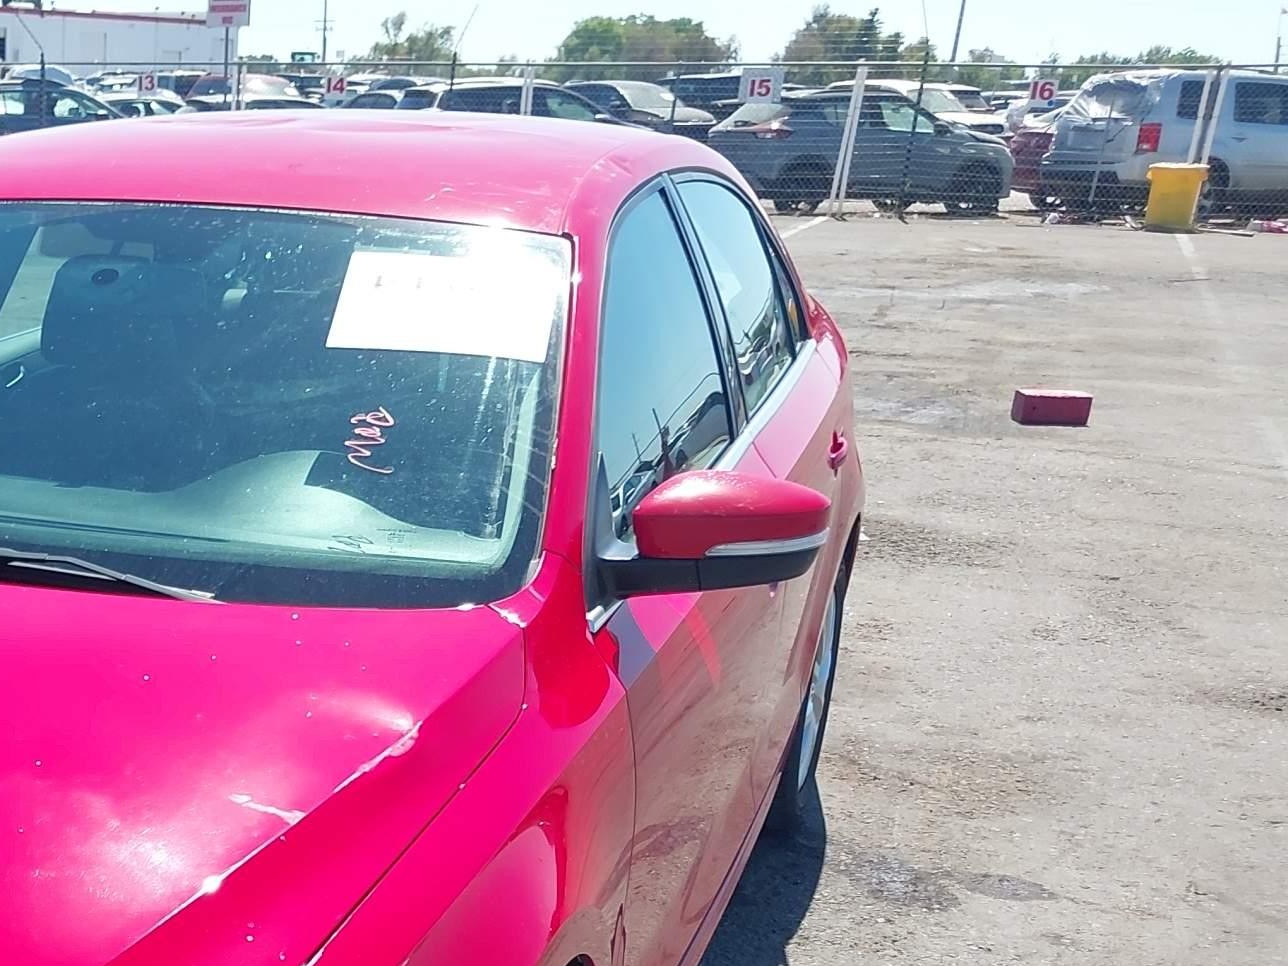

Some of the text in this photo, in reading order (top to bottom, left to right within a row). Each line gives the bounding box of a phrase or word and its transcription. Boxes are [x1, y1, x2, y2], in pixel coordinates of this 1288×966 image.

[137, 75, 155, 92] 13
[326, 77, 345, 94] 14
[748, 78, 771, 98] 15
[1030, 81, 1055, 101] 16
